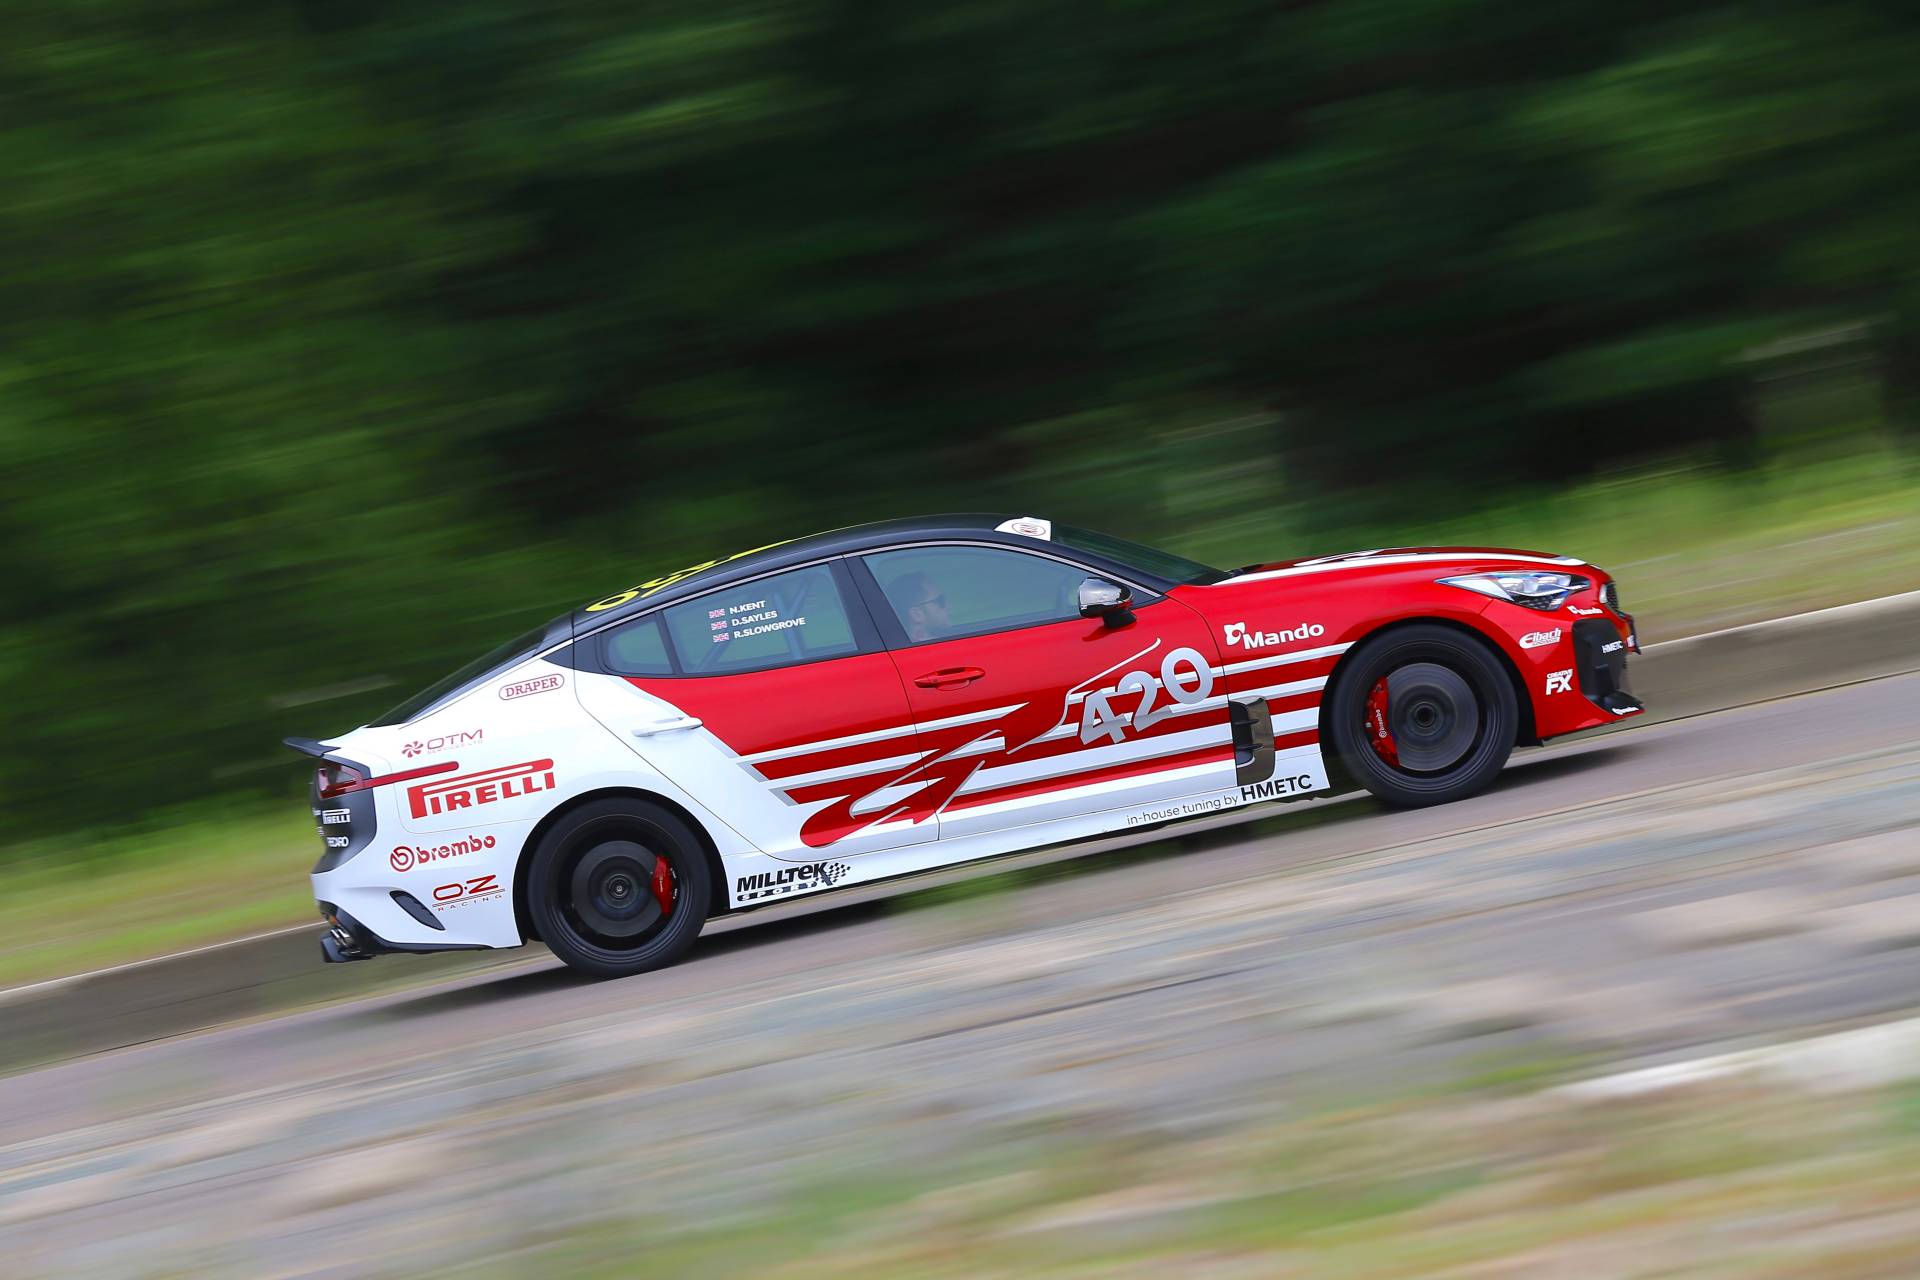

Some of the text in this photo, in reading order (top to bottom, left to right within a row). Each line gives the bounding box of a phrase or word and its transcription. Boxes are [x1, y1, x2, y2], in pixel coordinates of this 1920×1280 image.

[729, 600, 766, 615] N.KENT
[731, 611, 778, 627] D.SAYLES
[734, 617, 806, 639] R.SLOWGROVE
[1244, 622, 1324, 650] Mando
[505, 677, 559, 698] DRAPER
[1546, 669, 1573, 695] FX
[427, 728, 483, 750] OTM
[407, 758, 556, 820] PIRELLI
[1127, 774, 1313, 826] in-house tuning by HMETC
[416, 835, 496, 865] brembo
[438, 895, 503, 911] RACING
